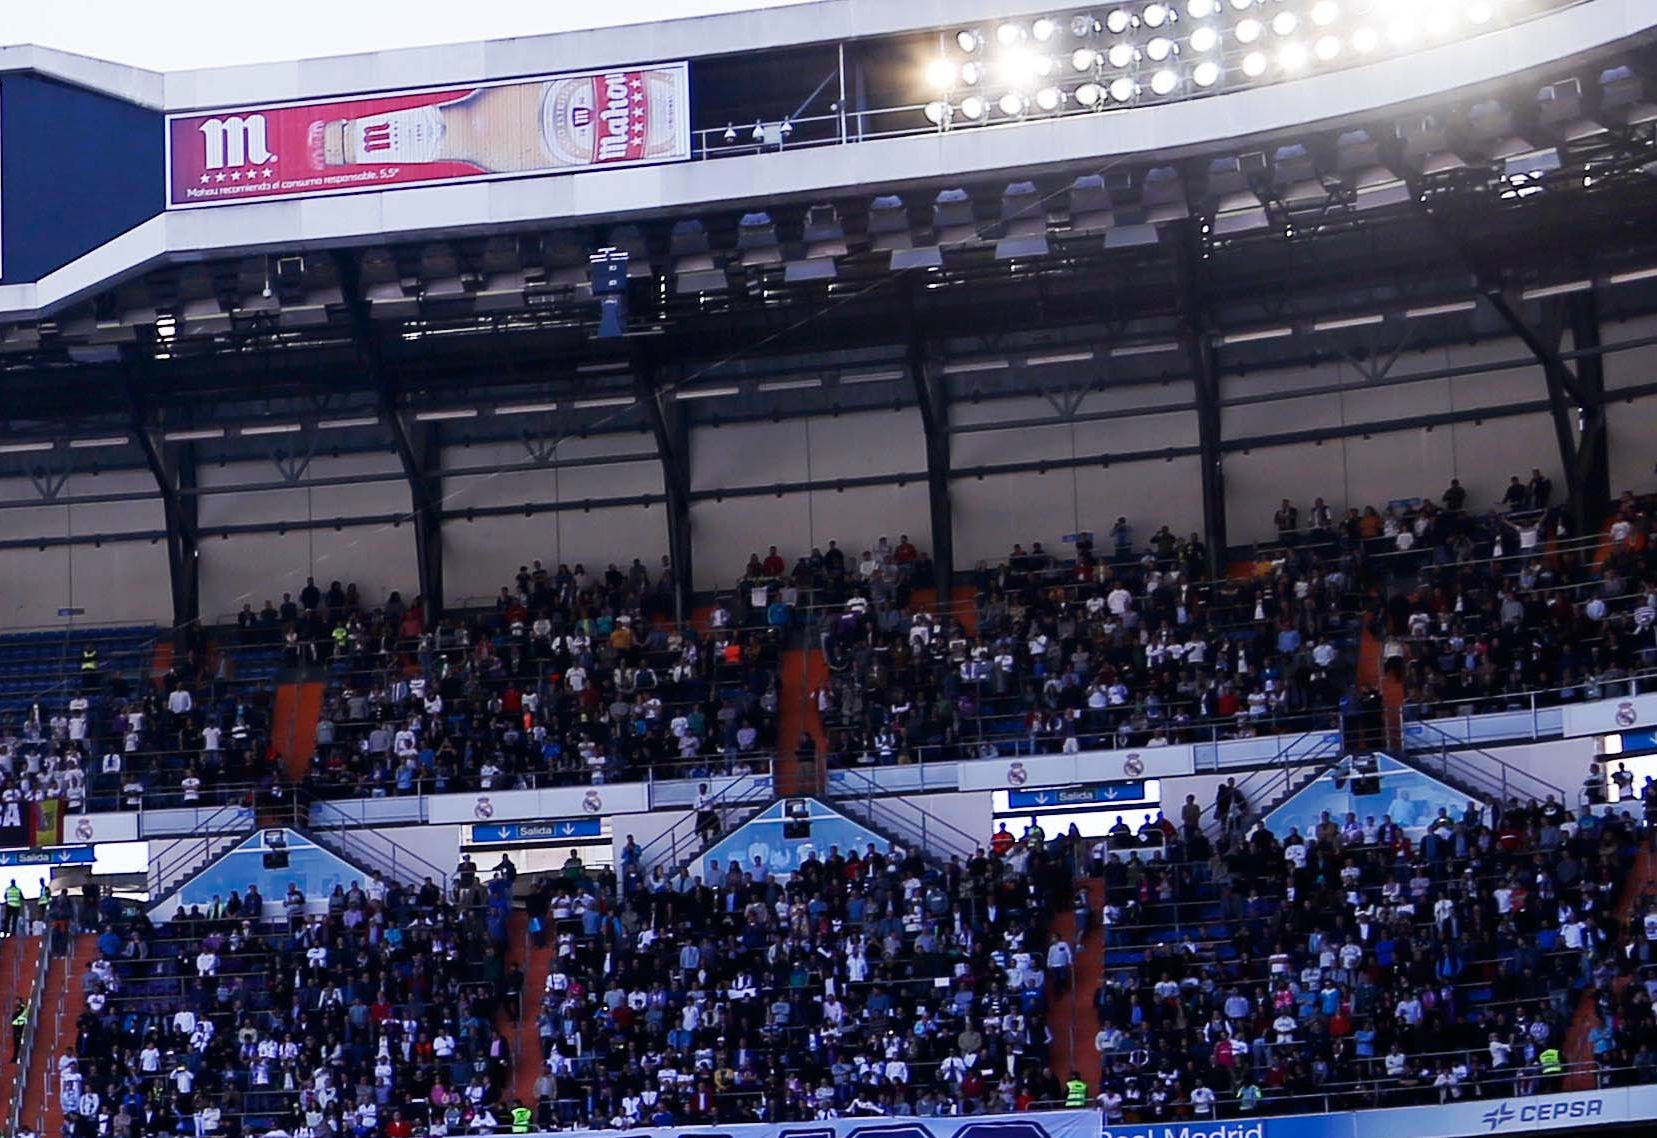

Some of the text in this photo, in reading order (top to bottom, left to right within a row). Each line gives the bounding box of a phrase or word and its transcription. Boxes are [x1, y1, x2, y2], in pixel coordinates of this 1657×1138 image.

[1059, 791, 1093, 801] Salida
[520, 825, 553, 836] Salida
[19, 852, 50, 863] Salida
[1521, 1099, 1604, 1123] CEPSA
